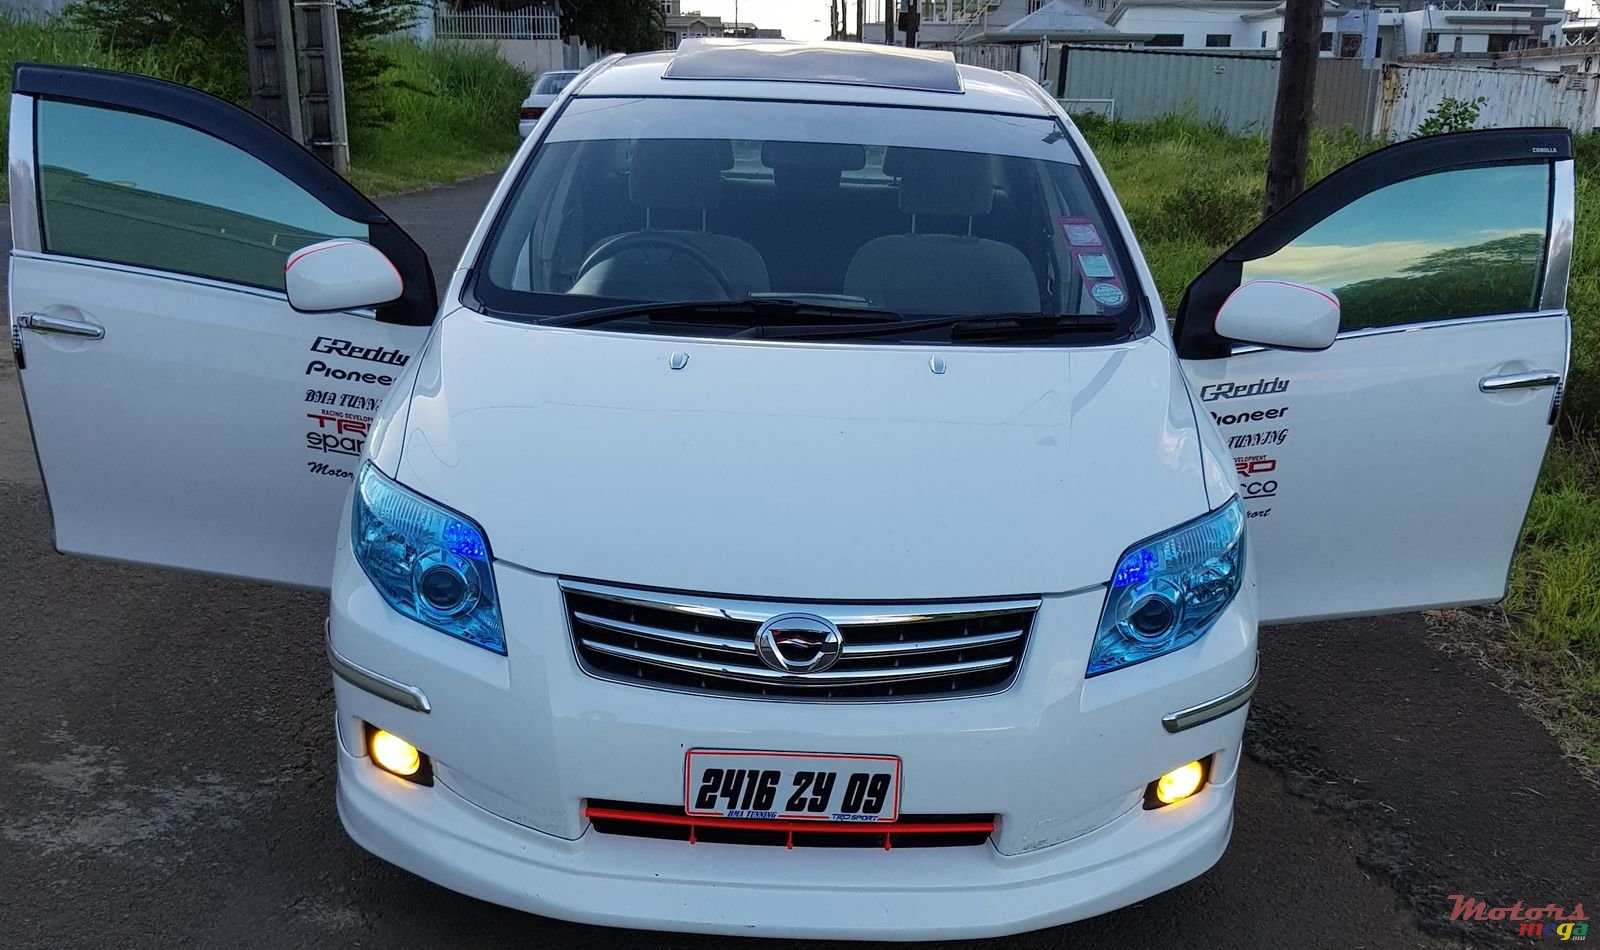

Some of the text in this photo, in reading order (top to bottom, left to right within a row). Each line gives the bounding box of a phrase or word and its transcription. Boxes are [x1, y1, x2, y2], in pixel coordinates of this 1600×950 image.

[310, 336, 410, 367] GReddy
[305, 360, 397, 386] Pionee
[305, 389, 337, 405] BMA
[1200, 377, 1290, 402] GReddy
[307, 413, 371, 438] TR
[321, 409, 343, 418] RACING
[695, 768, 892, 814] 2416 ZY 09
[832, 813, 879, 822] TRD SPORT
